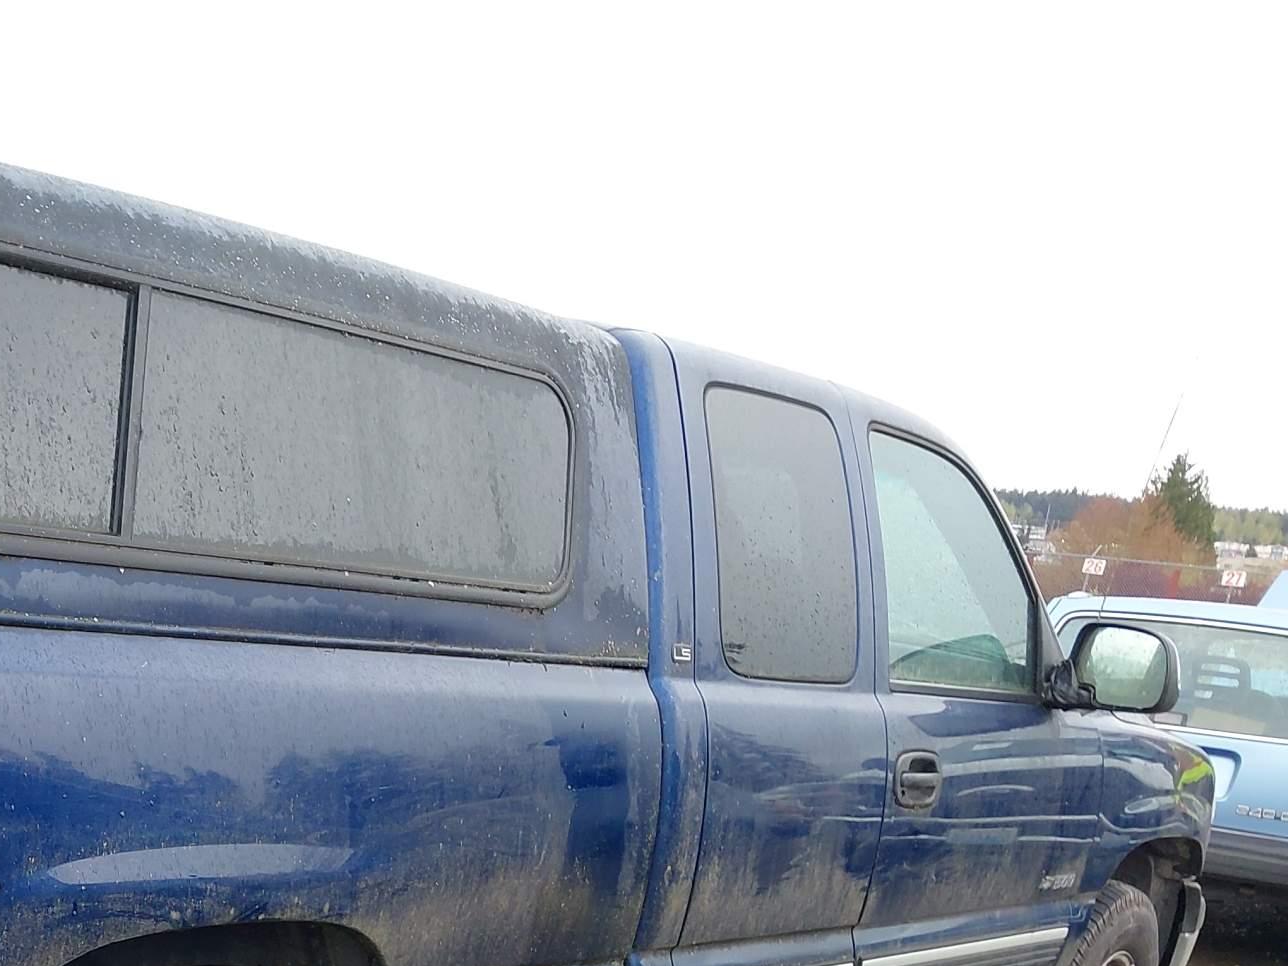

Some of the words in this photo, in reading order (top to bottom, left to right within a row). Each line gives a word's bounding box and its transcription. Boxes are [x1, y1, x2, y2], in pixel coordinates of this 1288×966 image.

[1084, 559, 1104, 573] 26
[1224, 571, 1244, 585] 27
[673, 646, 691, 661] LS
